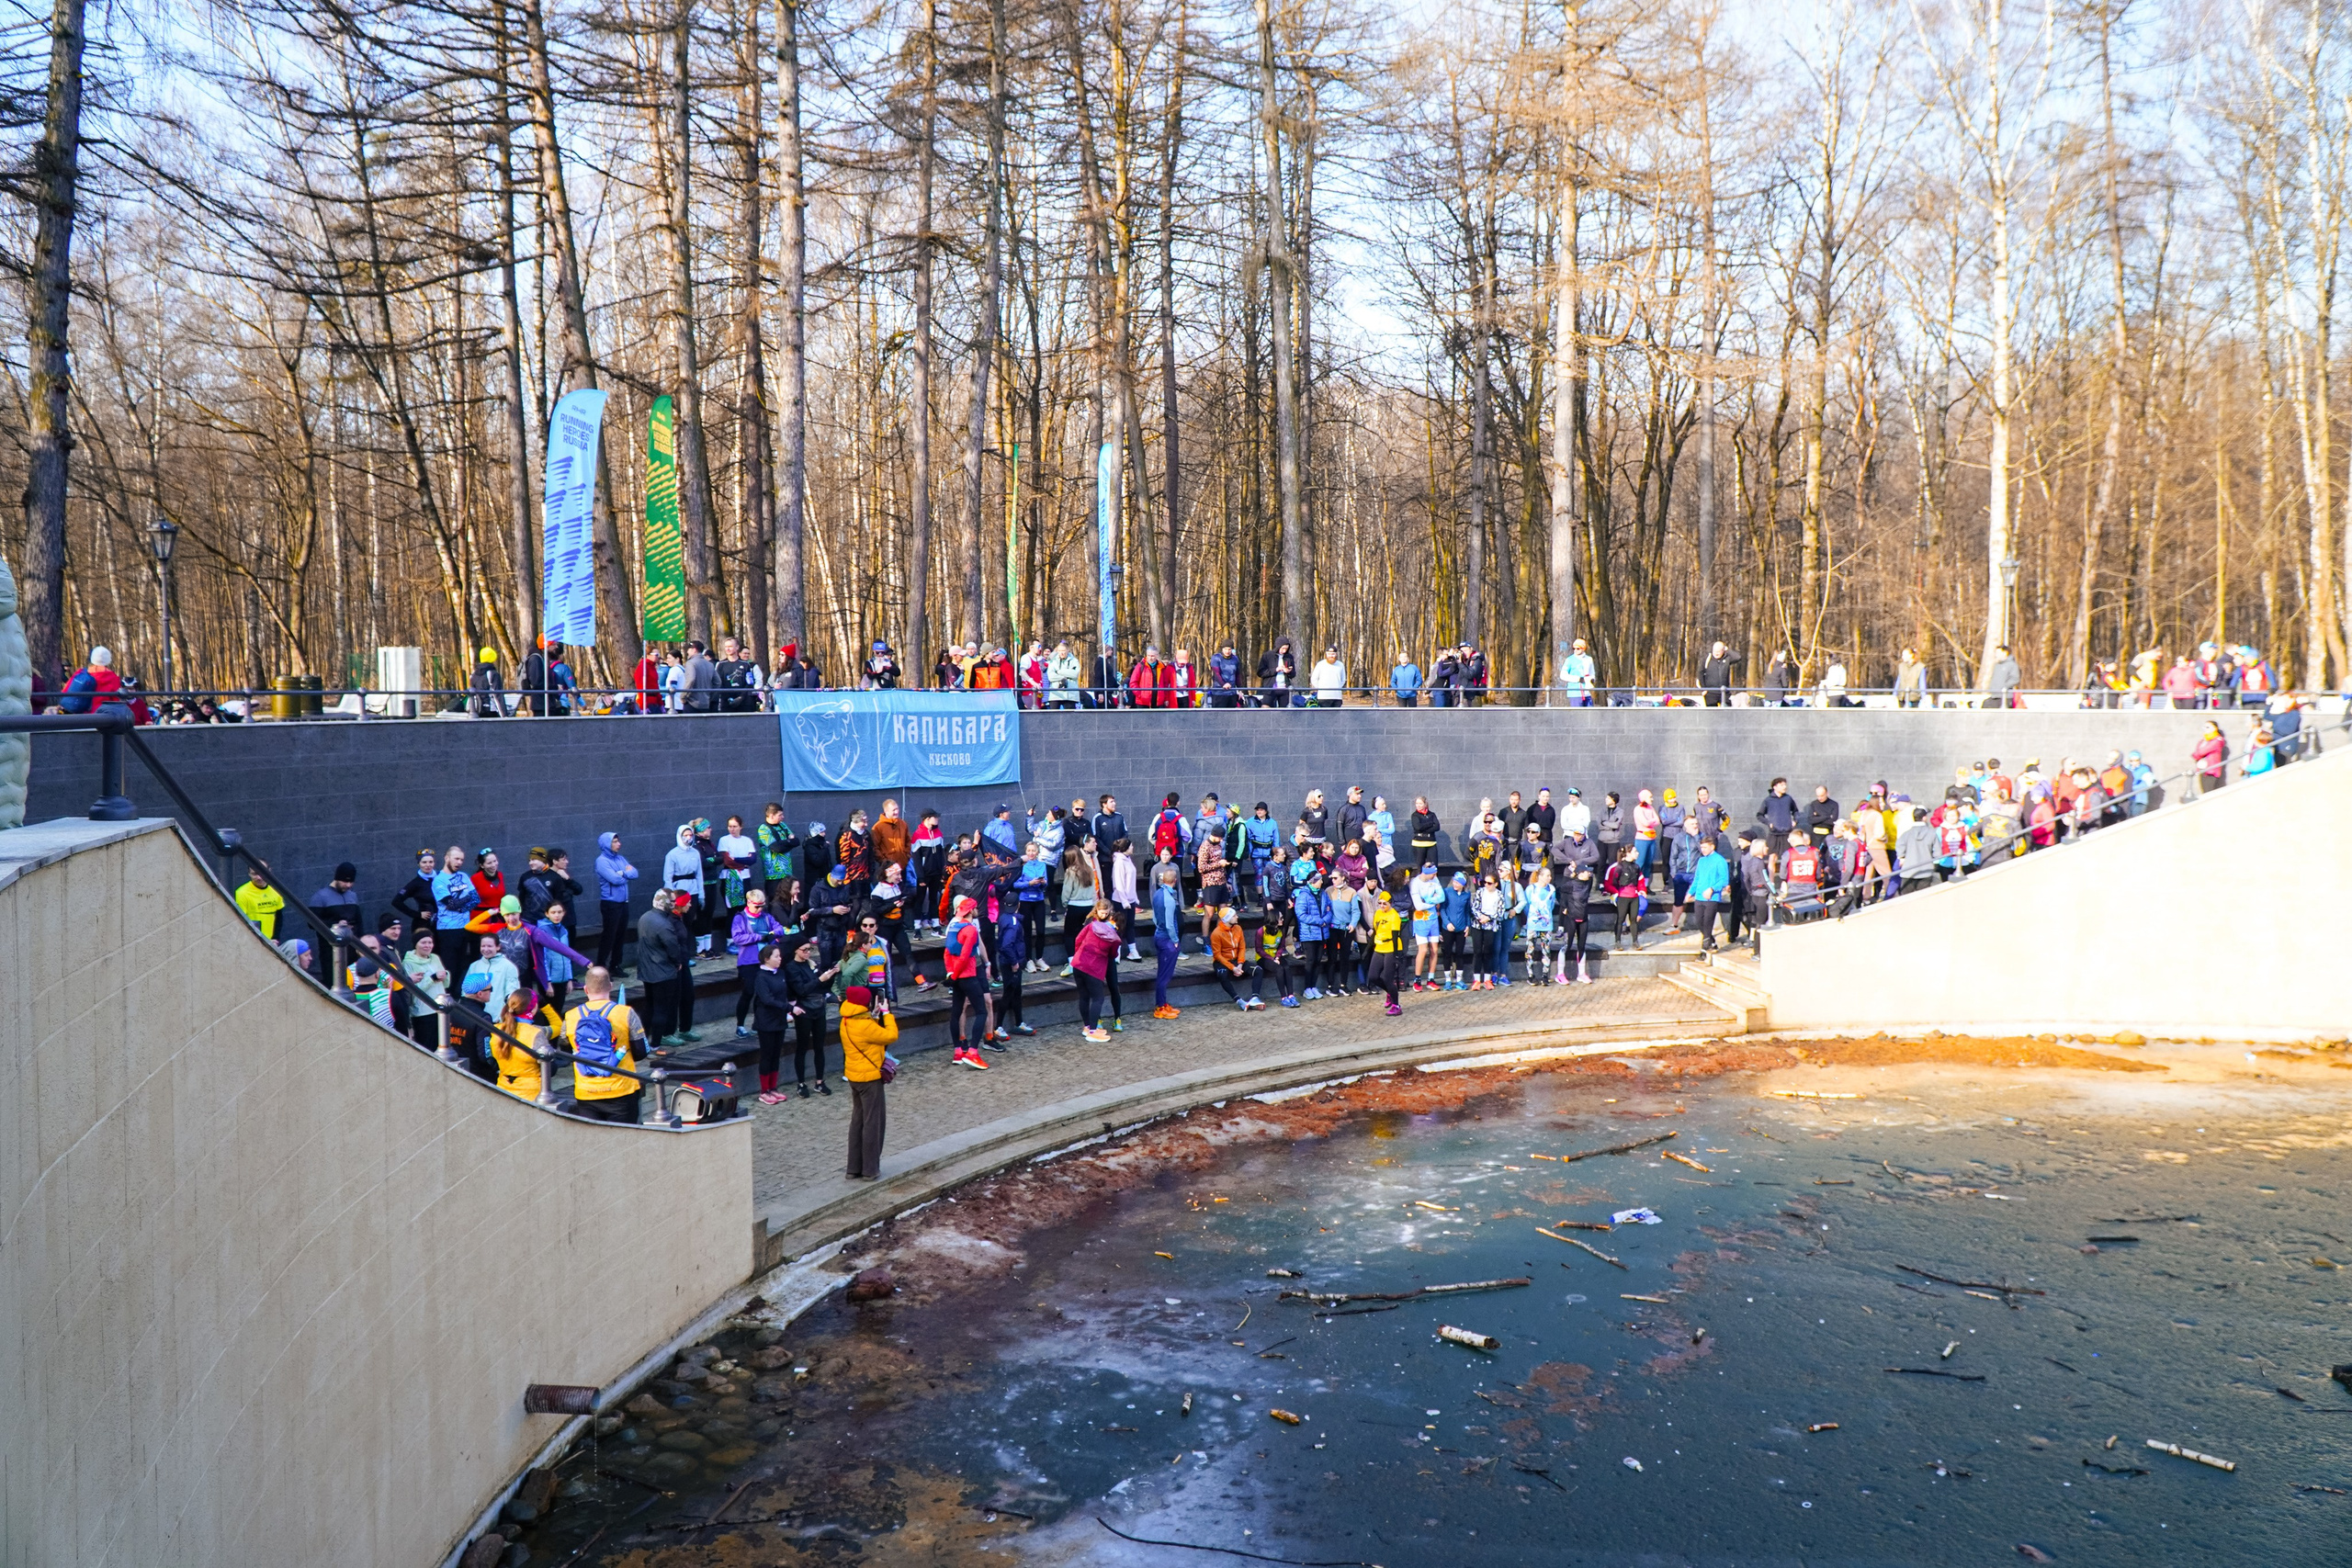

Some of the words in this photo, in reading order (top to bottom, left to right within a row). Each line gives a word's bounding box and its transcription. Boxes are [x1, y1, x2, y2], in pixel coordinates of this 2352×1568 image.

[560, 412, 594, 434] RUNNING
[562, 423, 590, 443] HEROES
[563, 434, 589, 452] RUSSIA
[892, 714, 1006, 745] КАПИБАРА
[929, 752, 971, 766] КУСКОВО
